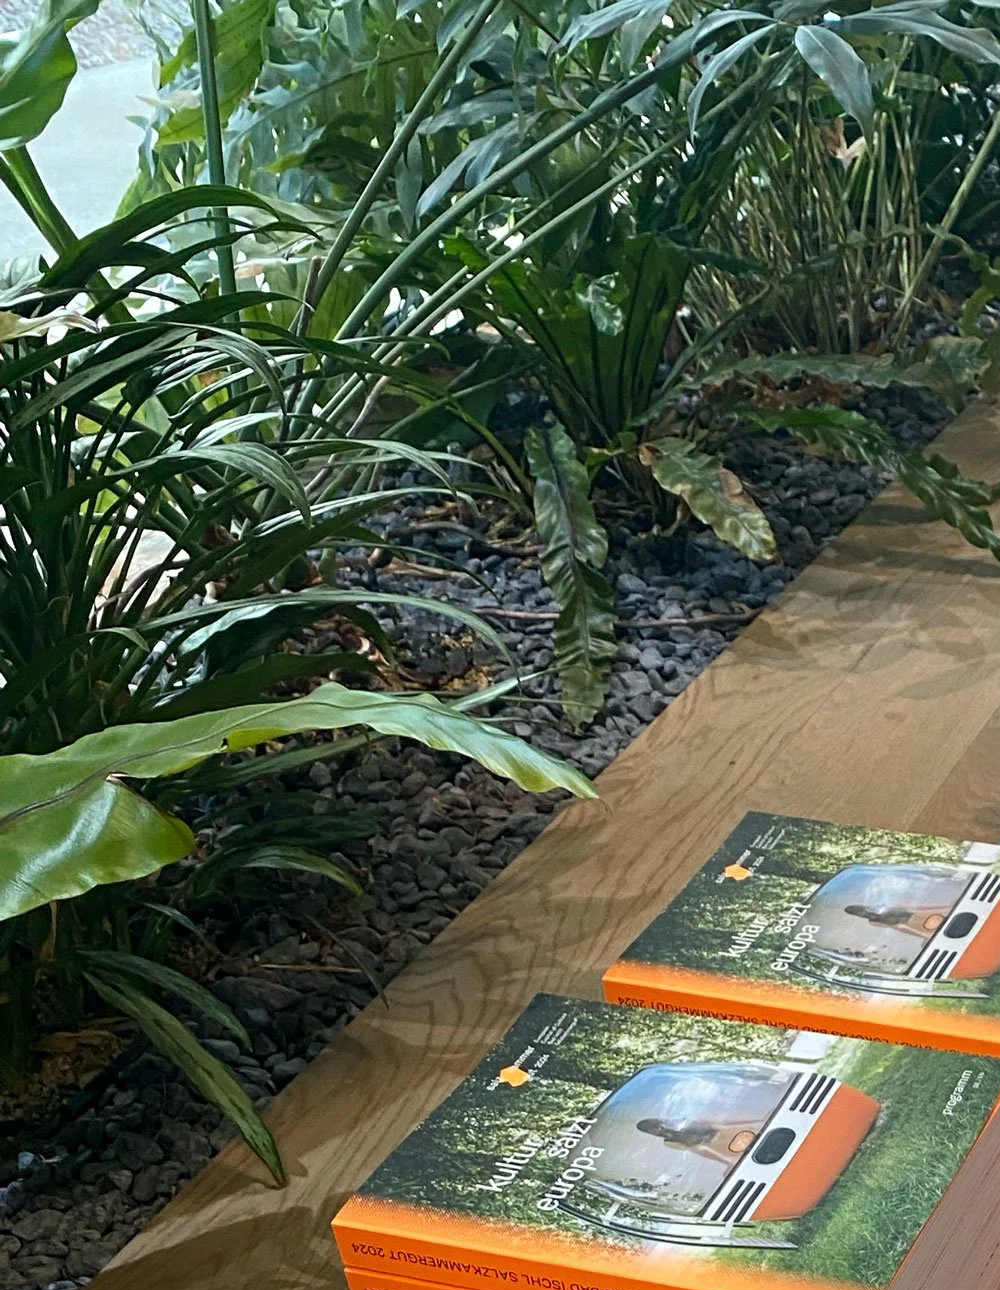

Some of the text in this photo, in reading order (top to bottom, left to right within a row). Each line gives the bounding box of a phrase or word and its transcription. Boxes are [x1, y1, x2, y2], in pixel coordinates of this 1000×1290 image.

[718, 914, 770, 958] kultur
[774, 902, 811, 934] salzt
[771, 924, 820, 971] europa
[617, 996, 645, 1009] 2024
[942, 1069, 973, 1116] programm
[547, 1116, 598, 1159] salzt
[476, 1137, 543, 1193] kultur
[536, 1145, 604, 1212] europa
[351, 1243, 385, 1257] 2024
[389, 1250, 518, 1282] SALZKAMMERGUT
[521, 1274, 565, 1290] ISCHL
